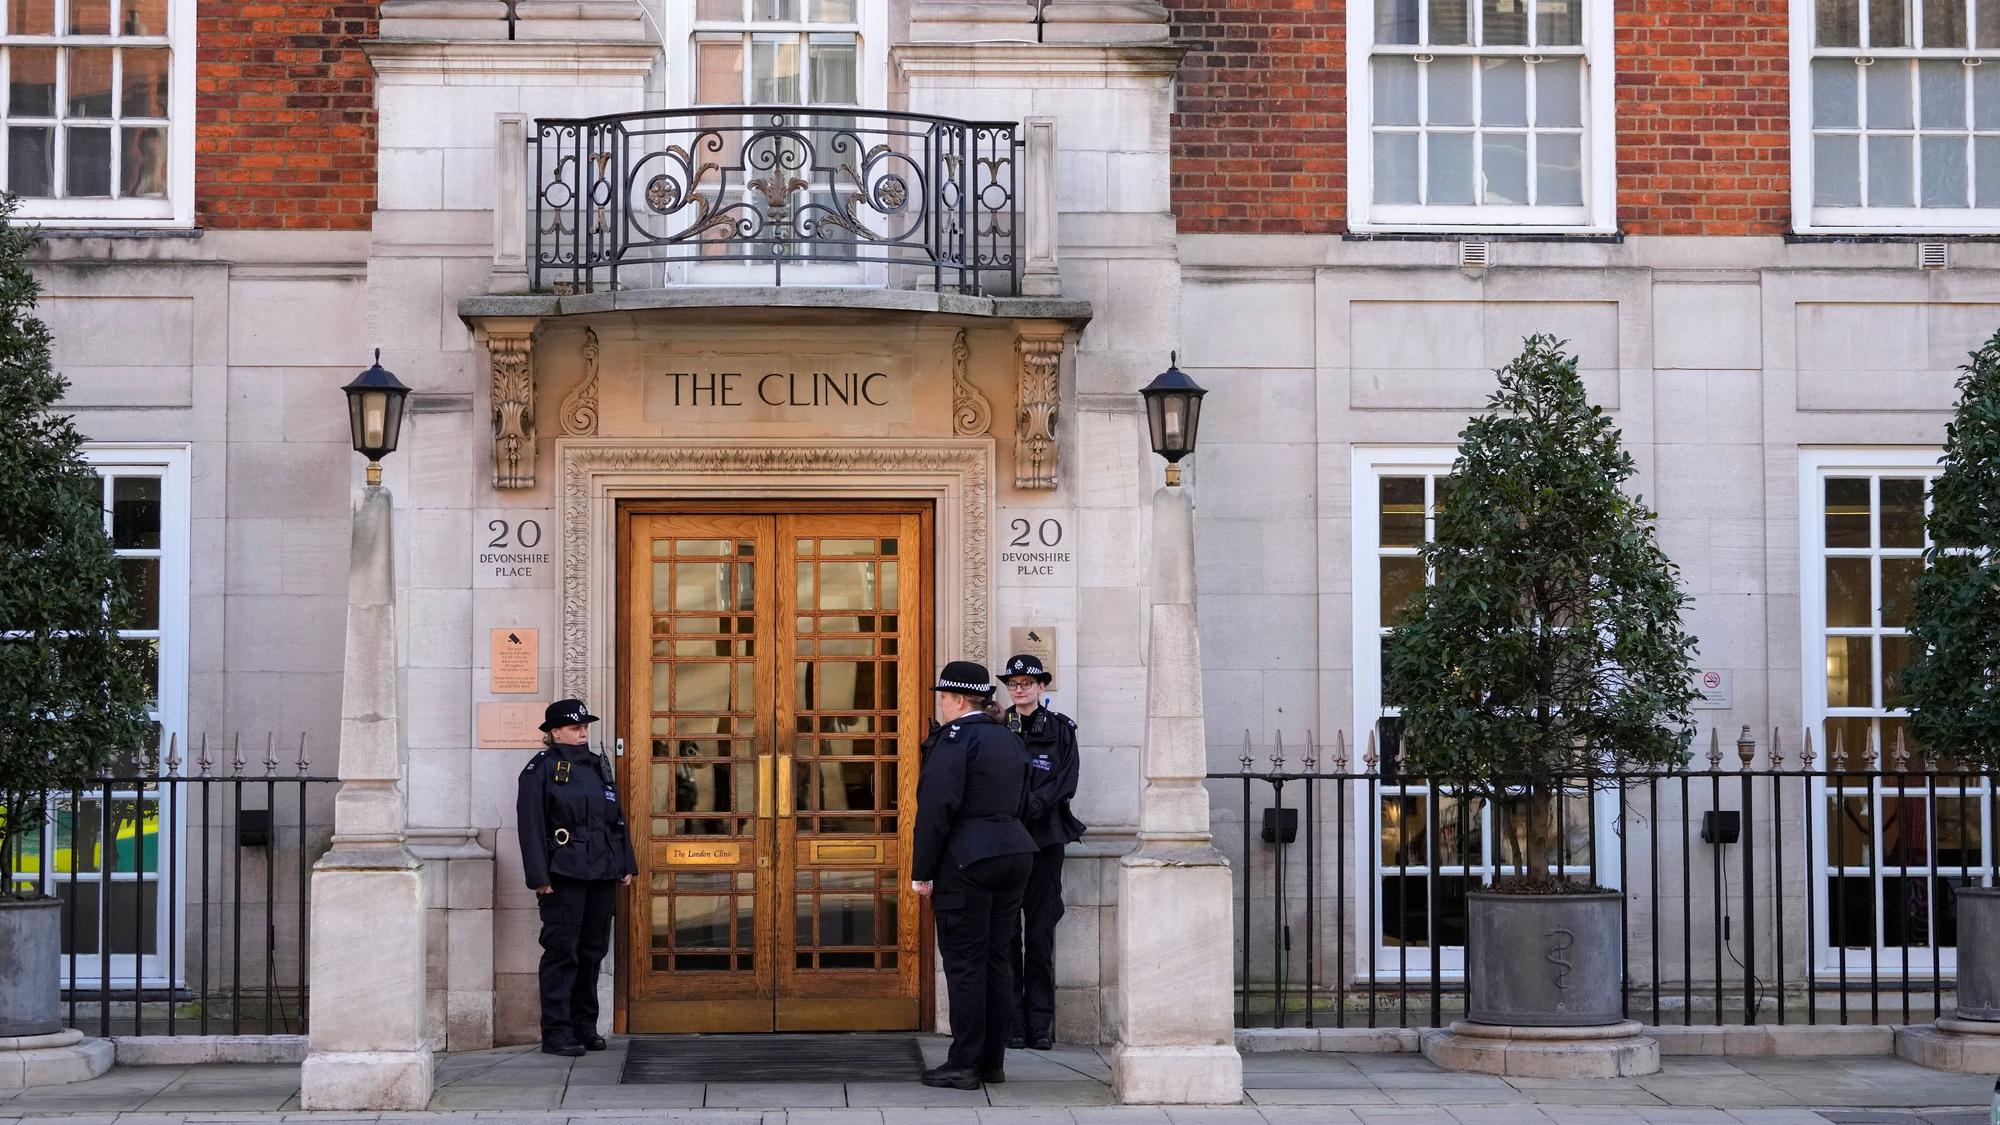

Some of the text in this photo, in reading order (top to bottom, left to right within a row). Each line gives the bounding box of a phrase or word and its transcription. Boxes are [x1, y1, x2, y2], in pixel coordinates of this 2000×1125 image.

[665, 373, 889, 406] THE CLINIC
[488, 519, 542, 548] 20
[1010, 519, 1063, 547] 20
[480, 553, 549, 563] DEVONSHIRE
[1002, 552, 1070, 562] DEVONSHIRE
[495, 567, 532, 577] PLACE
[1017, 565, 1053, 575] PLACE
[674, 849, 733, 858] The London Clinic
